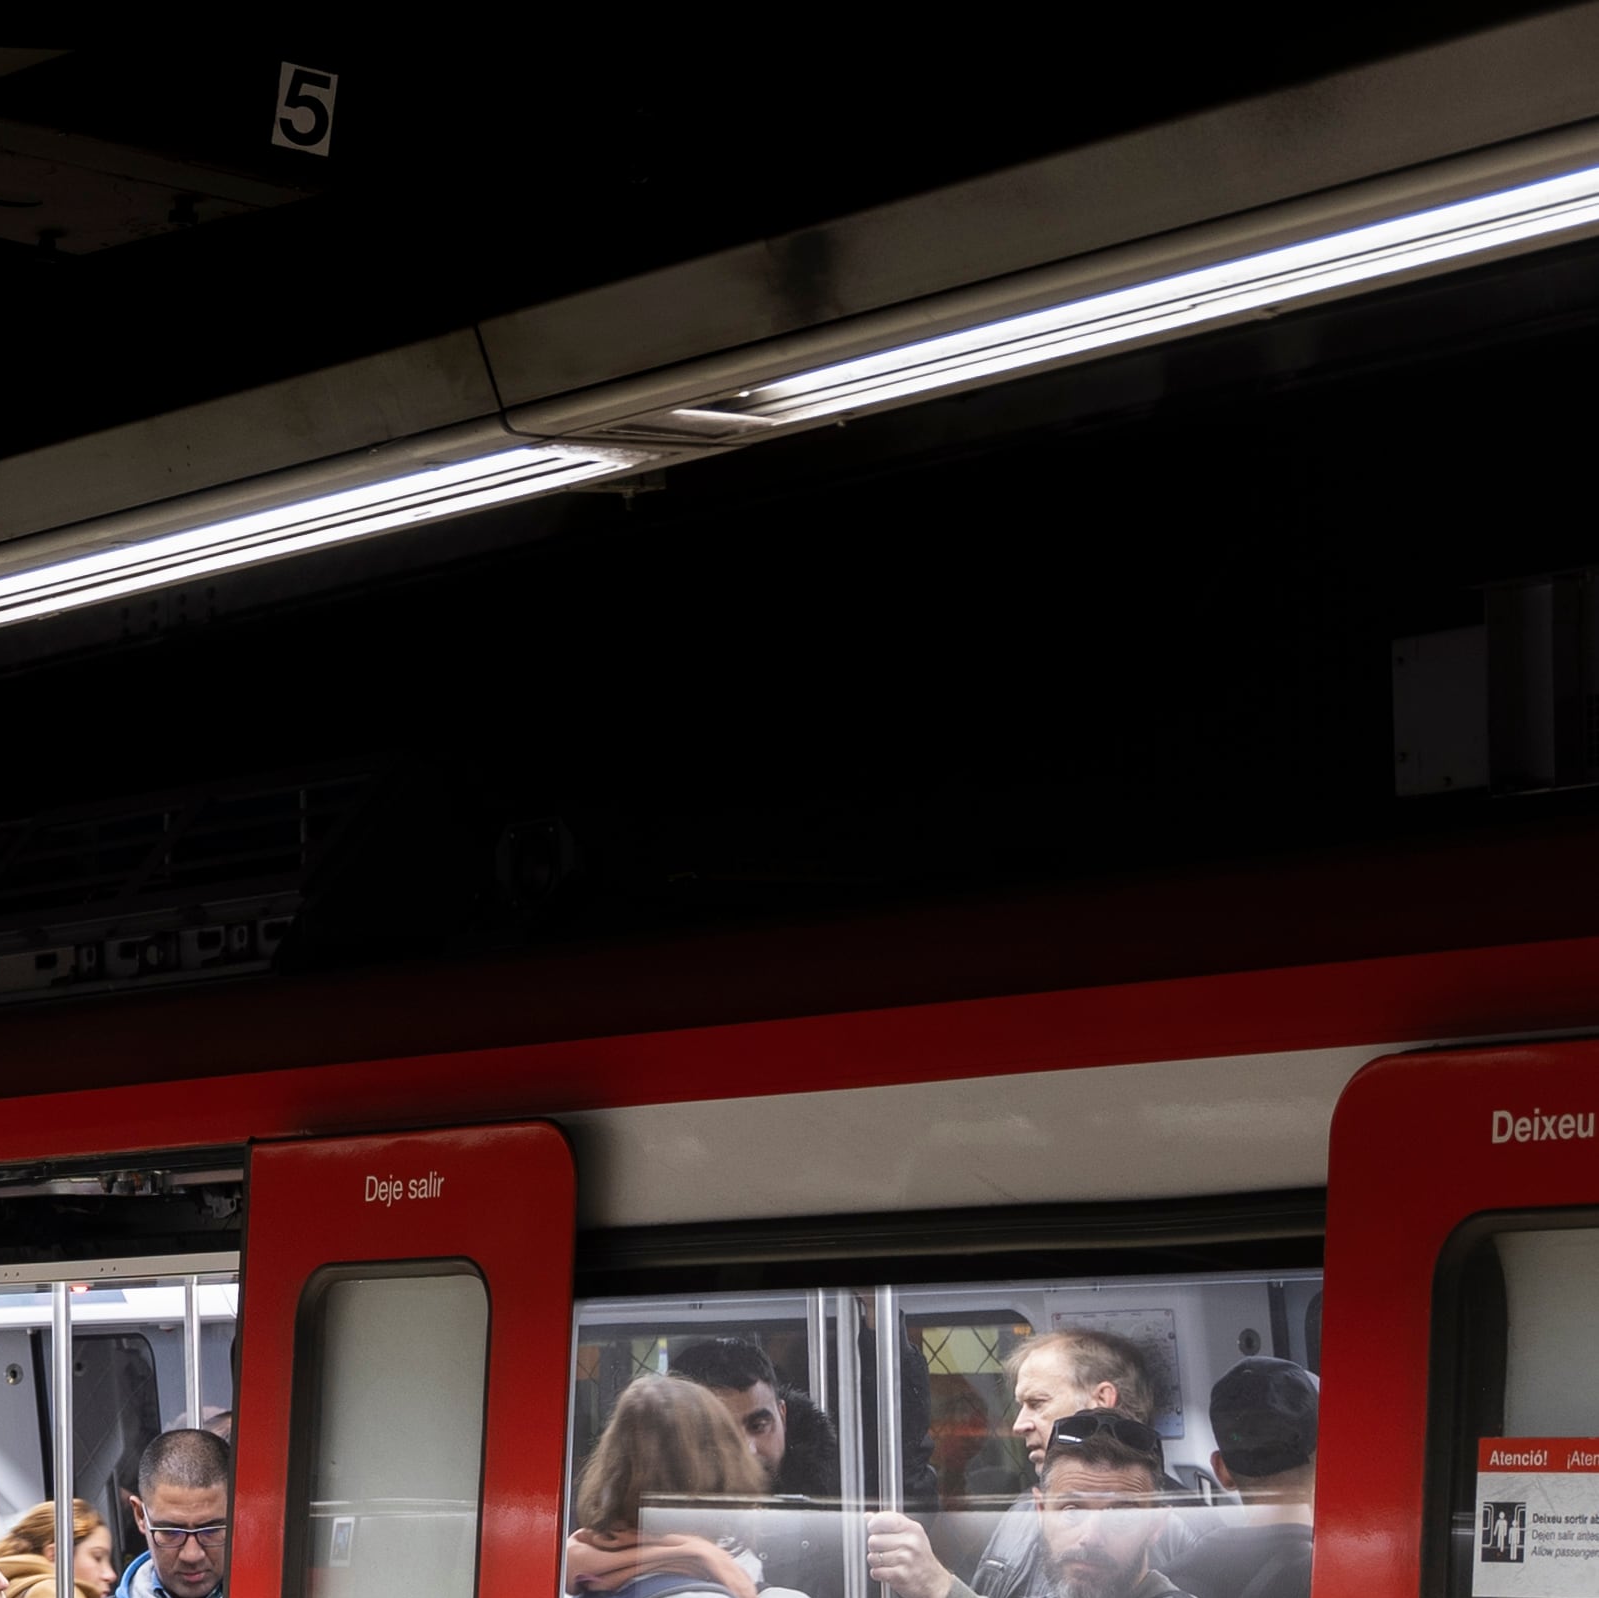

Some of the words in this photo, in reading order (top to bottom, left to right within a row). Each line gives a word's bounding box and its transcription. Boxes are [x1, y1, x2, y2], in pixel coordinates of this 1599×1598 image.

[279, 68, 331, 146] 5
[1491, 1107, 1595, 1144] Deixeu
[365, 1174, 403, 1207] Deje
[408, 1171, 444, 1199] salir
[1490, 1450, 1548, 1466] Atenció!
[1532, 1513, 1562, 1524] Deixeu
